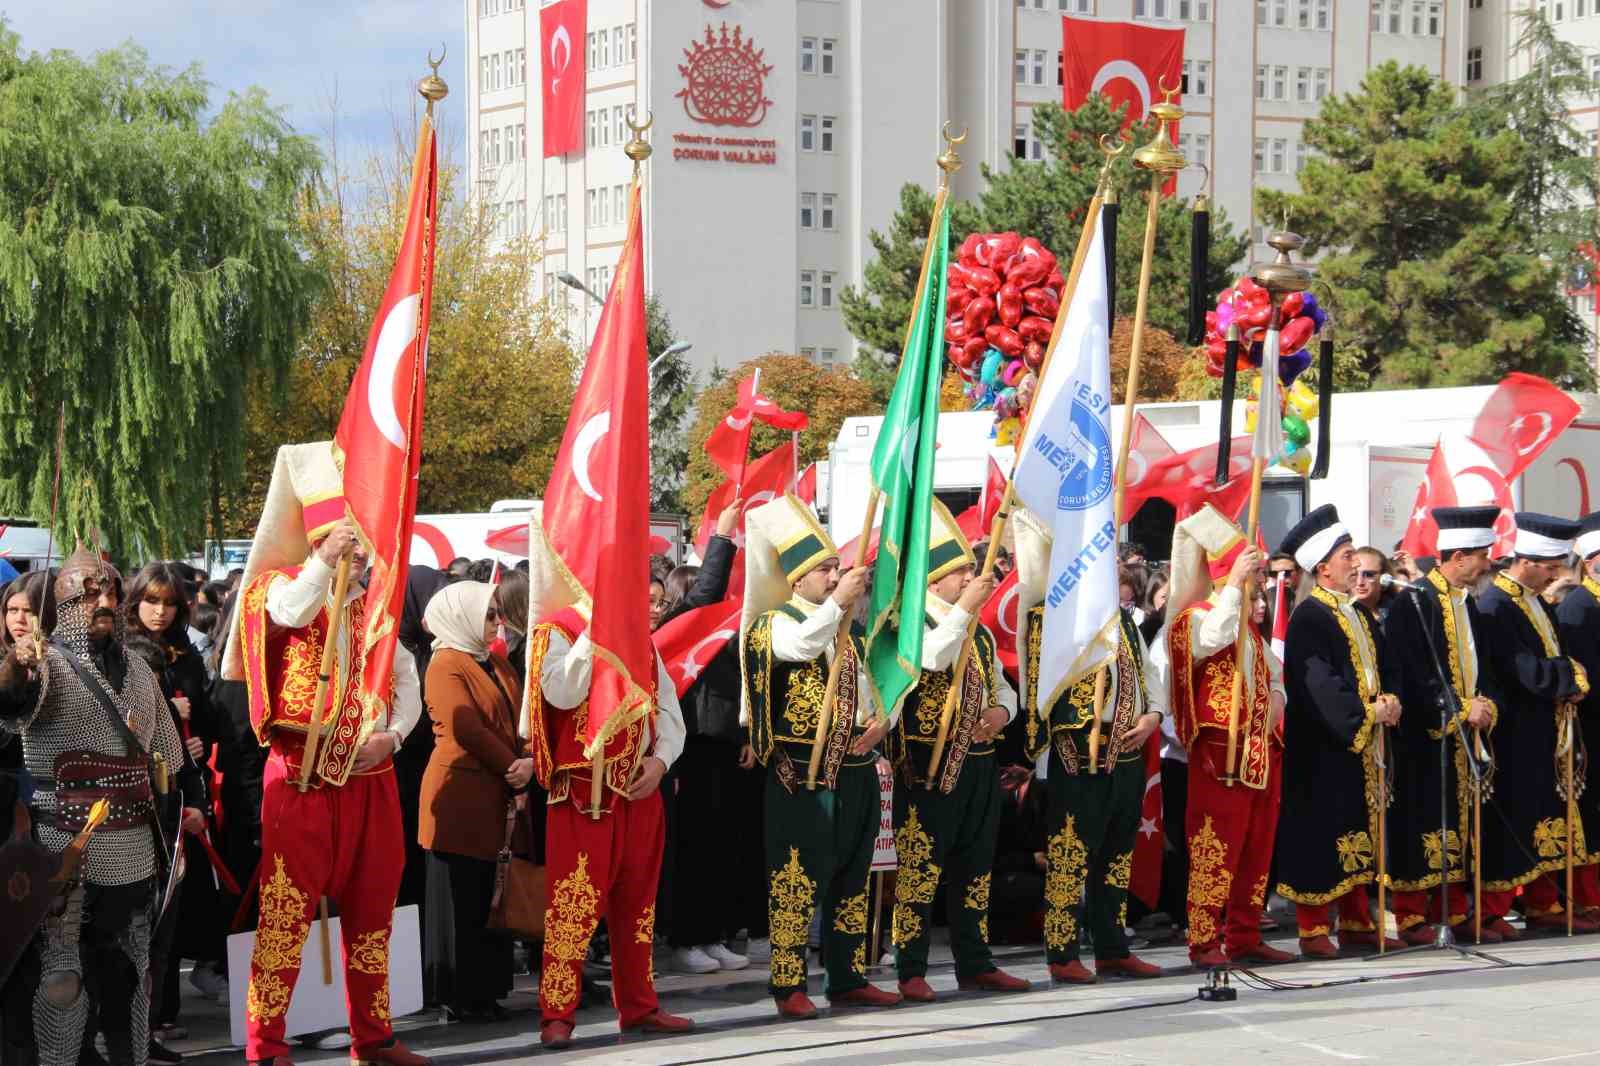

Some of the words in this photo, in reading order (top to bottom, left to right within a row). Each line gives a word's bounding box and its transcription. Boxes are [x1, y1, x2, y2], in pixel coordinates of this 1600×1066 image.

[673, 148, 720, 161] ÇORUM
[723, 150, 776, 165] VALİLİĞİ
[1047, 521, 1116, 608] MEHTER
